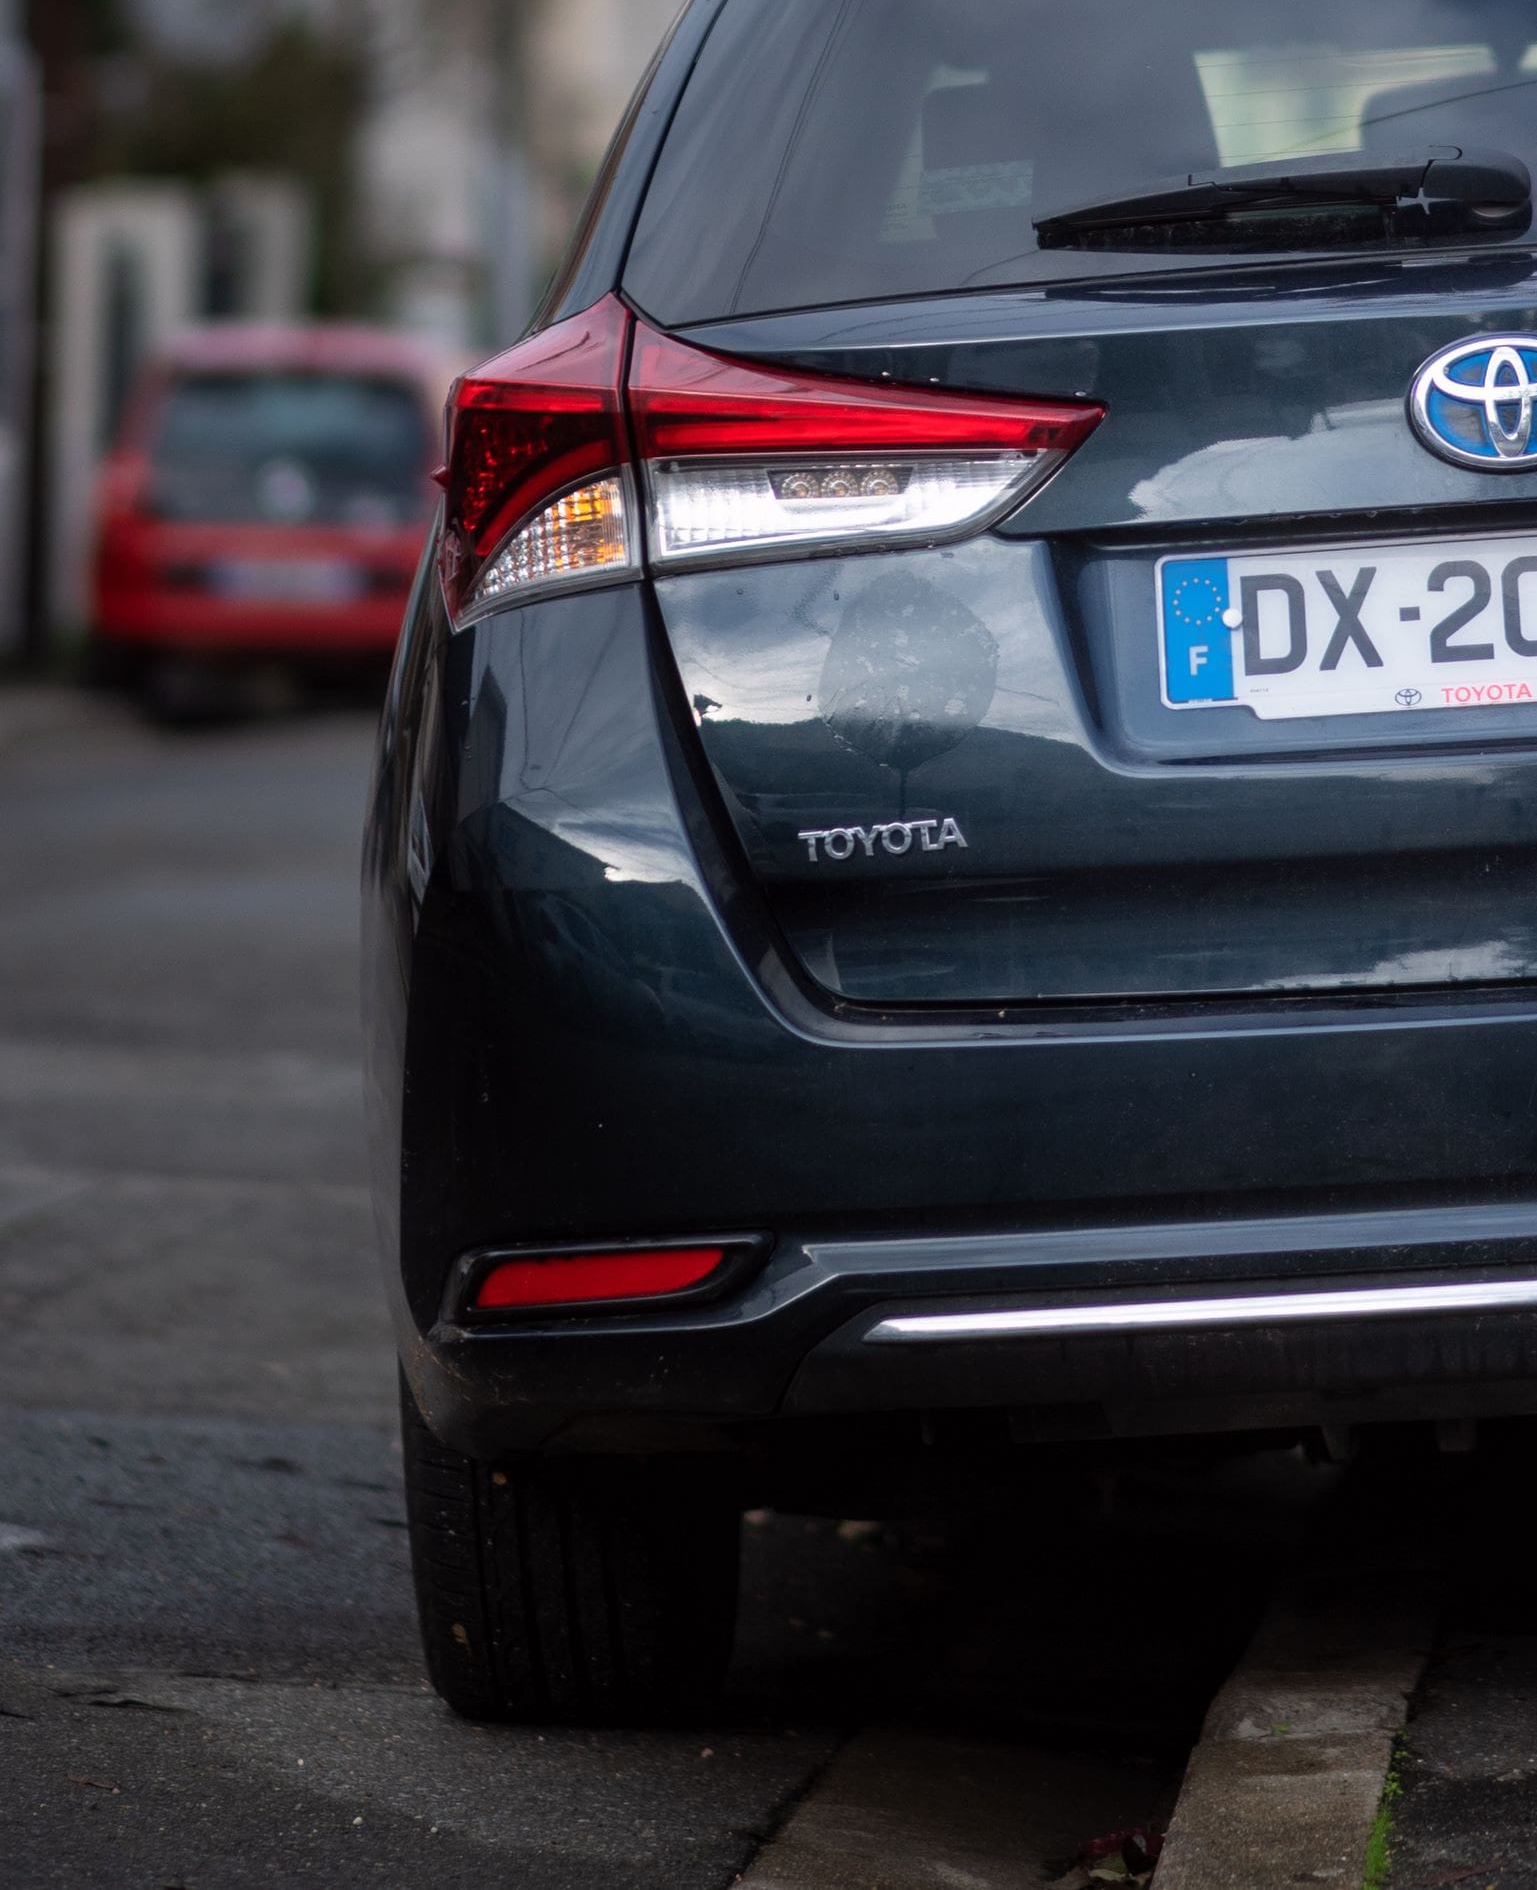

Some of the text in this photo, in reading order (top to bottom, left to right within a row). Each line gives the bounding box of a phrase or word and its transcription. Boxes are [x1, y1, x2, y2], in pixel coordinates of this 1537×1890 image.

[1189, 645, 1208, 676] F
[1441, 683, 1532, 703] TOYOTA
[798, 817, 968, 862] TOYOTA
